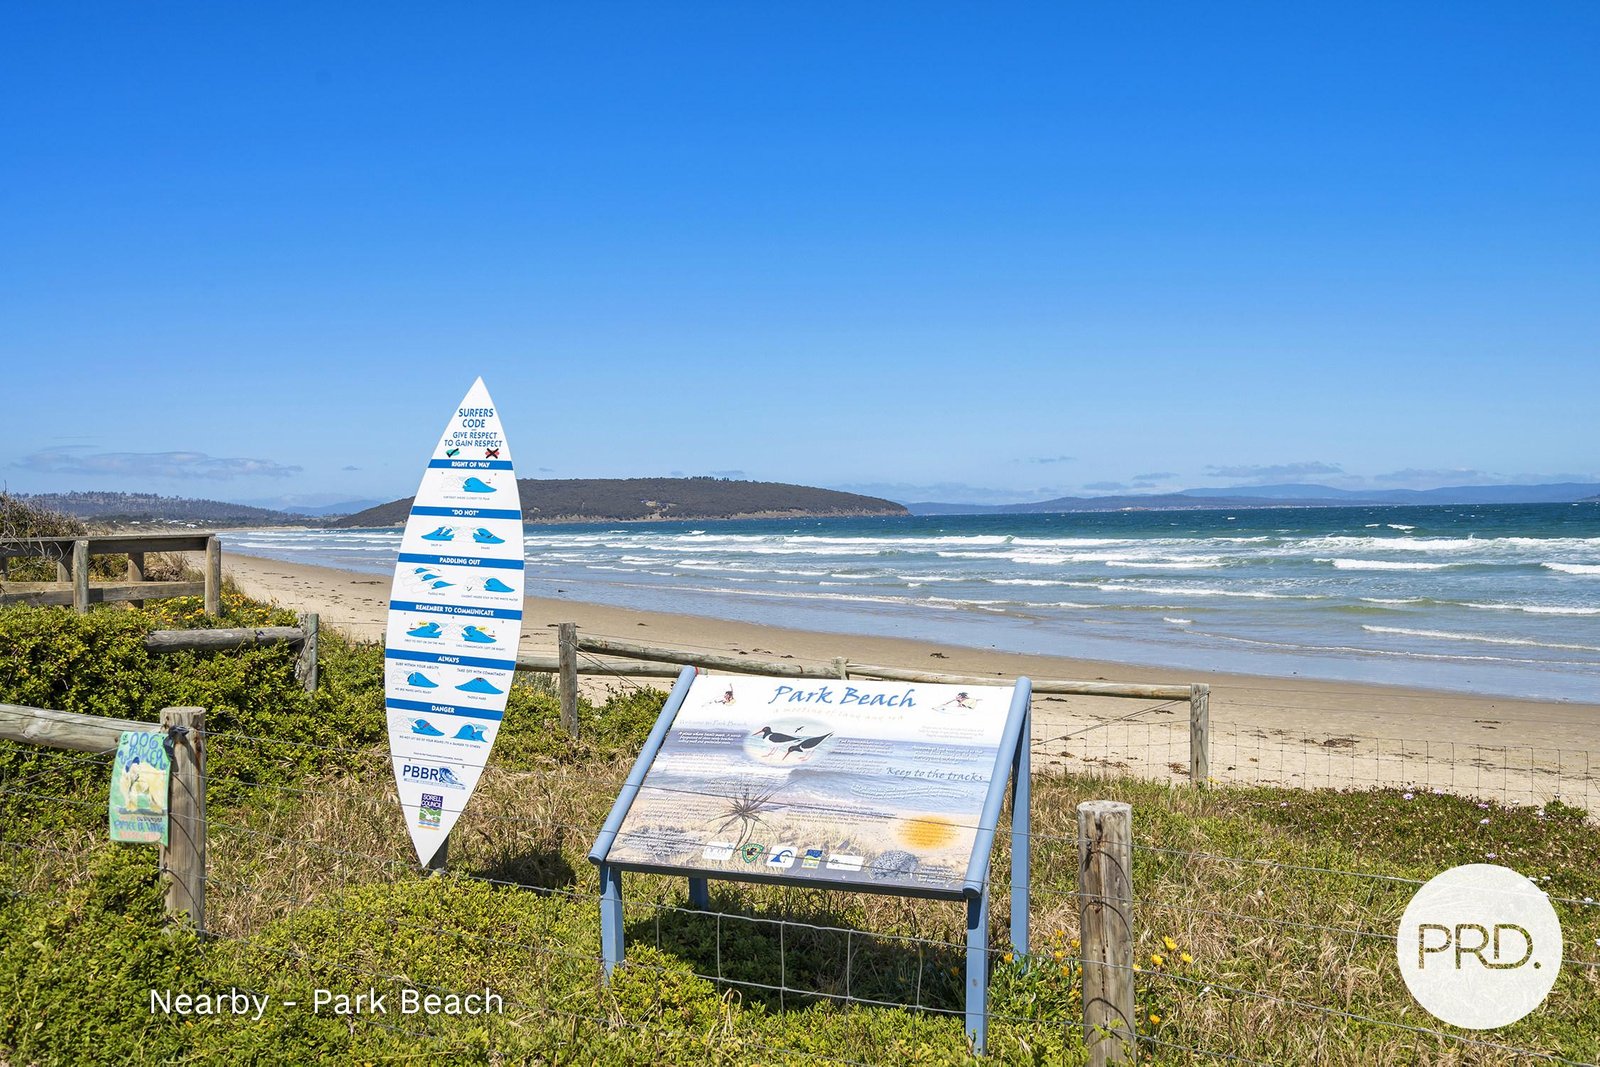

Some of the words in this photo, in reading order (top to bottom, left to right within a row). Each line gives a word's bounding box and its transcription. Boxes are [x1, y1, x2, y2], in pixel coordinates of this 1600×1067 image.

[458, 408, 494, 417] SURFERS
[462, 419, 485, 428] CODE
[439, 557, 467, 565] PADDLING
[416, 604, 443, 612] REMEMBER
[454, 608, 494, 616] COMMUNICATE
[437, 656, 460, 664] ALWAYS
[768, 685, 833, 705] Park
[840, 686, 916, 708] Beach
[432, 705, 455, 714] DANGER
[402, 764, 439, 781] PBBR
[886, 767, 912, 781] Keep
[914, 769, 925, 777] to
[927, 768, 944, 779] the
[947, 772, 983, 781] tracks
[421, 800, 442, 808] COUNCIL
